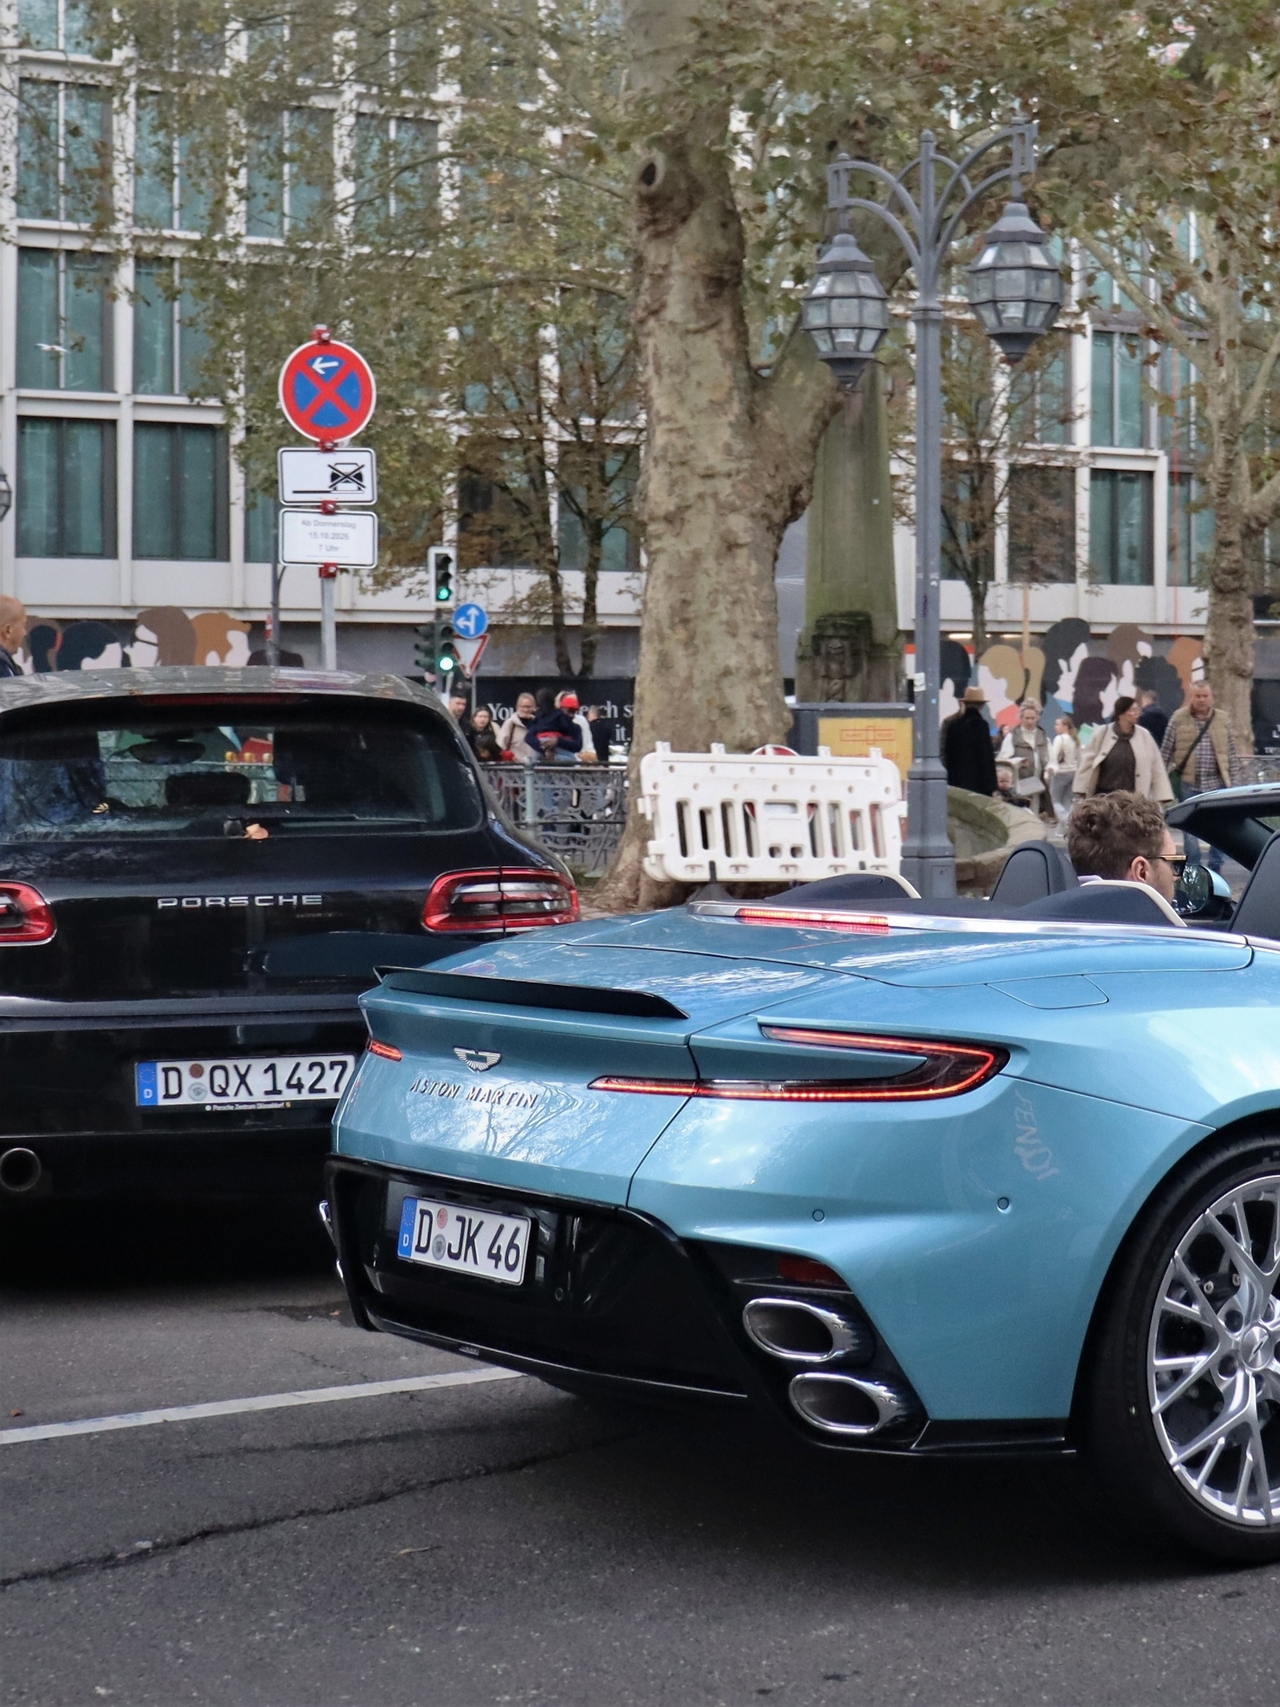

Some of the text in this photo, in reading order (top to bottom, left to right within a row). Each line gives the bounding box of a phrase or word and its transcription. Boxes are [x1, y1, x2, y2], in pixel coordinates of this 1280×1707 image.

[157, 894, 323, 910] PORSCHE
[162, 1060, 348, 1100] D QX 1427
[144, 1088, 152, 1099] D
[410, 1078, 539, 1109] ASTON MARTIN
[402, 1233, 410, 1247] D
[414, 1208, 521, 1272] D JK 46
